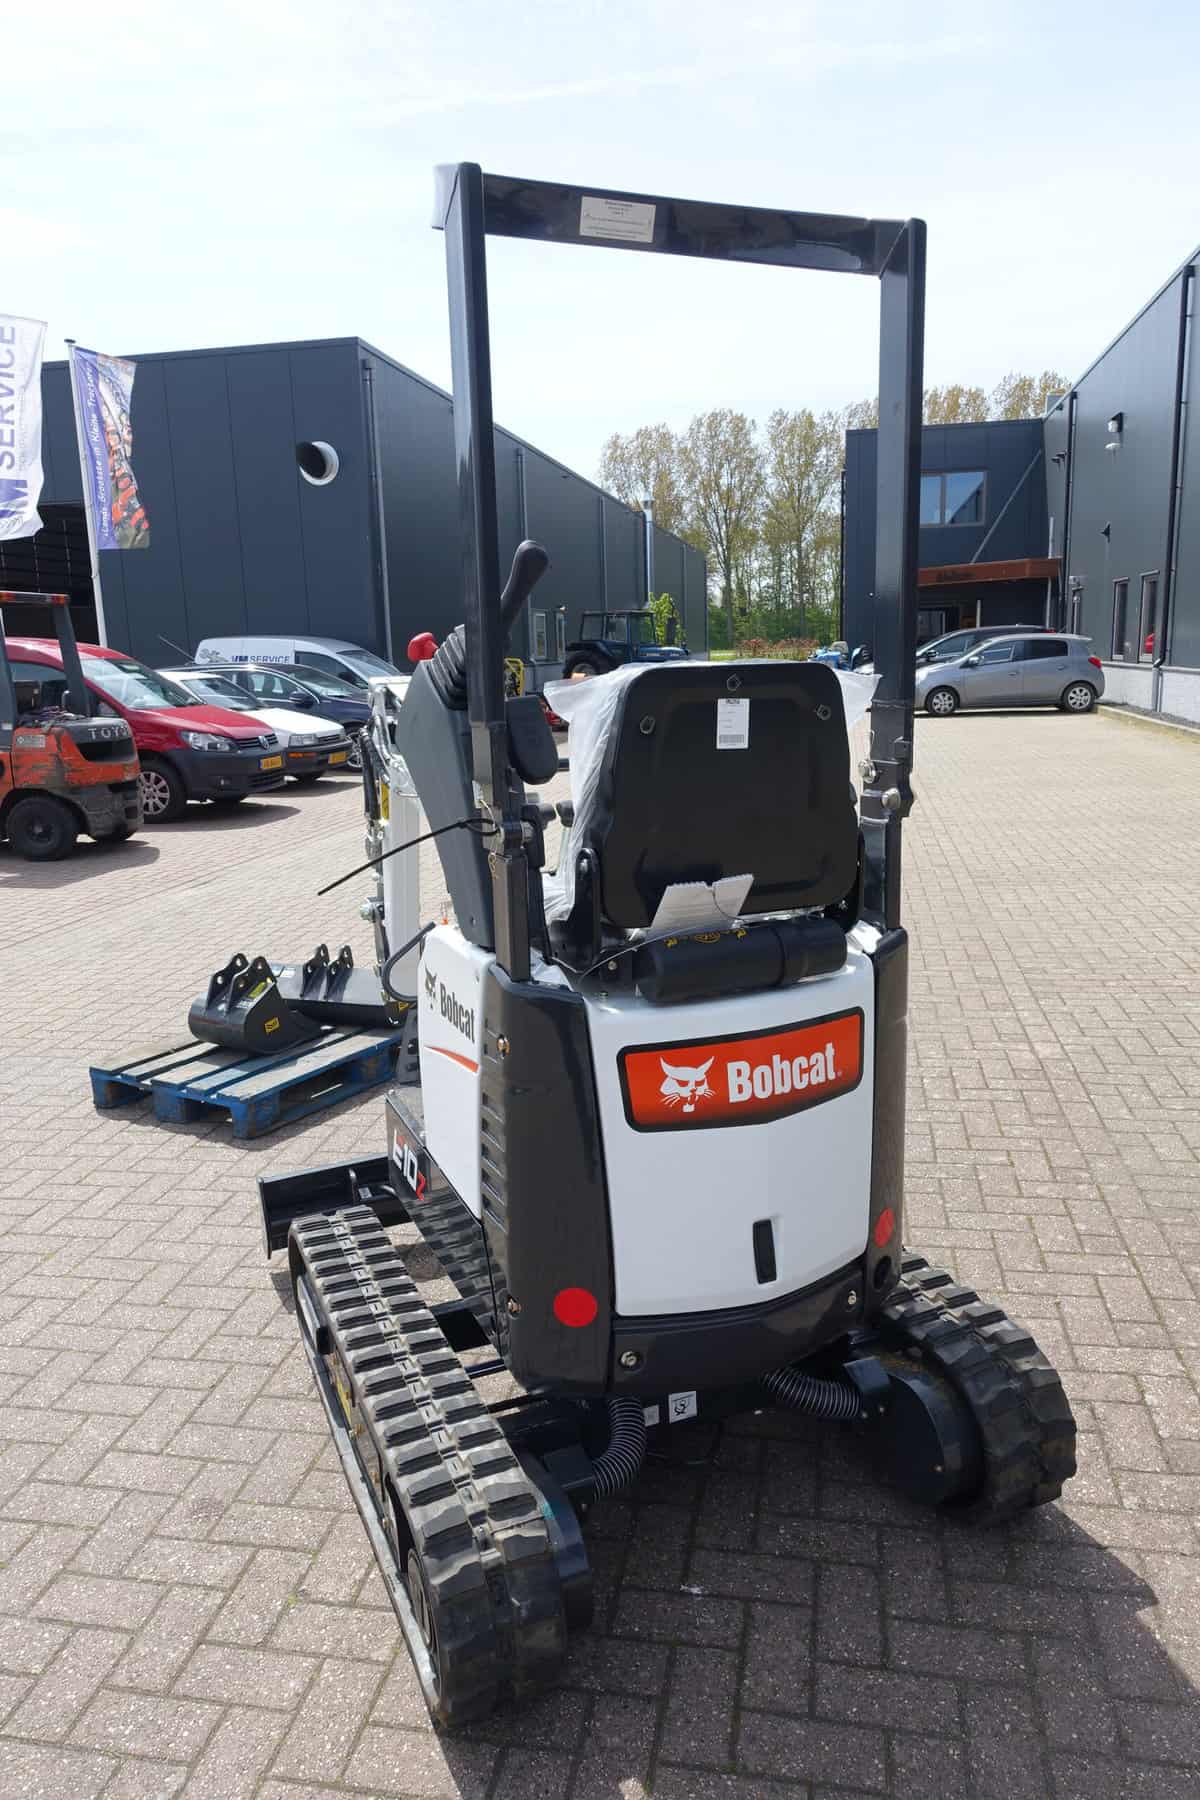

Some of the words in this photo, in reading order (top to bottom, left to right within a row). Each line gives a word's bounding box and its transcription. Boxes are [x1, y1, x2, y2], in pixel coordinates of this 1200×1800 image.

[250, 656, 290, 665] SERVICE
[440, 982, 475, 1045] Bobcat
[727, 1042, 836, 1103] Bobcat
